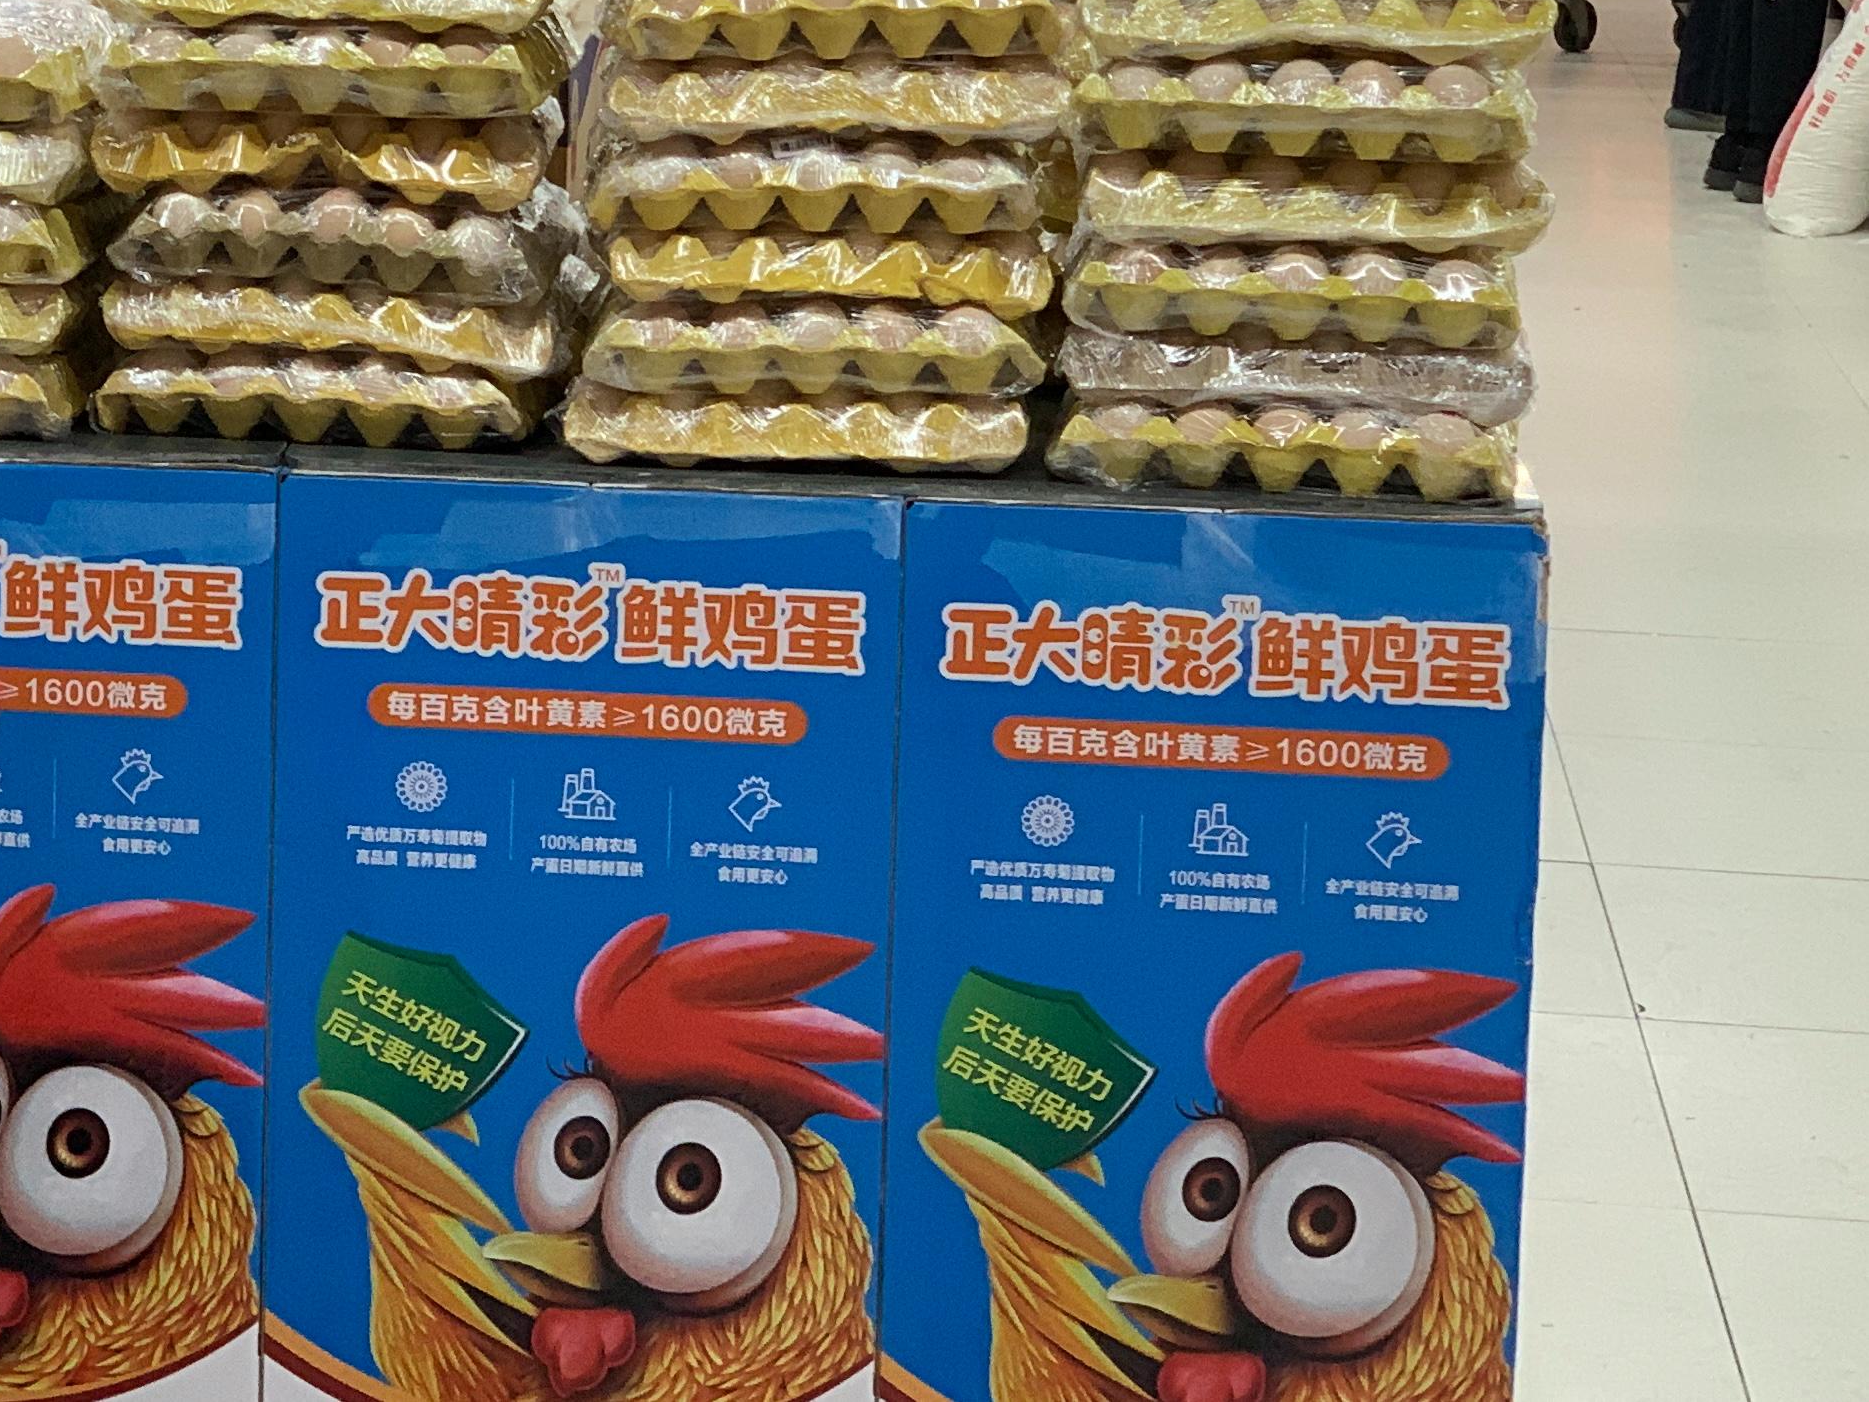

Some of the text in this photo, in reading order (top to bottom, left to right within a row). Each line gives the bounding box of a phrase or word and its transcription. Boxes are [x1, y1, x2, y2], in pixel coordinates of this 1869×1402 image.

[388, 691, 787, 738] 每百克含叶黄素≥1600微克
[1013, 724, 1427, 772] 每百克含叶黄素≥1600微克
[322, 1006, 470, 1095] 后天要保护
[341, 970, 488, 1064] 天生好视力
[962, 1005, 1115, 1102] 天生好视力
[942, 1045, 1095, 1136] 后天要保护
